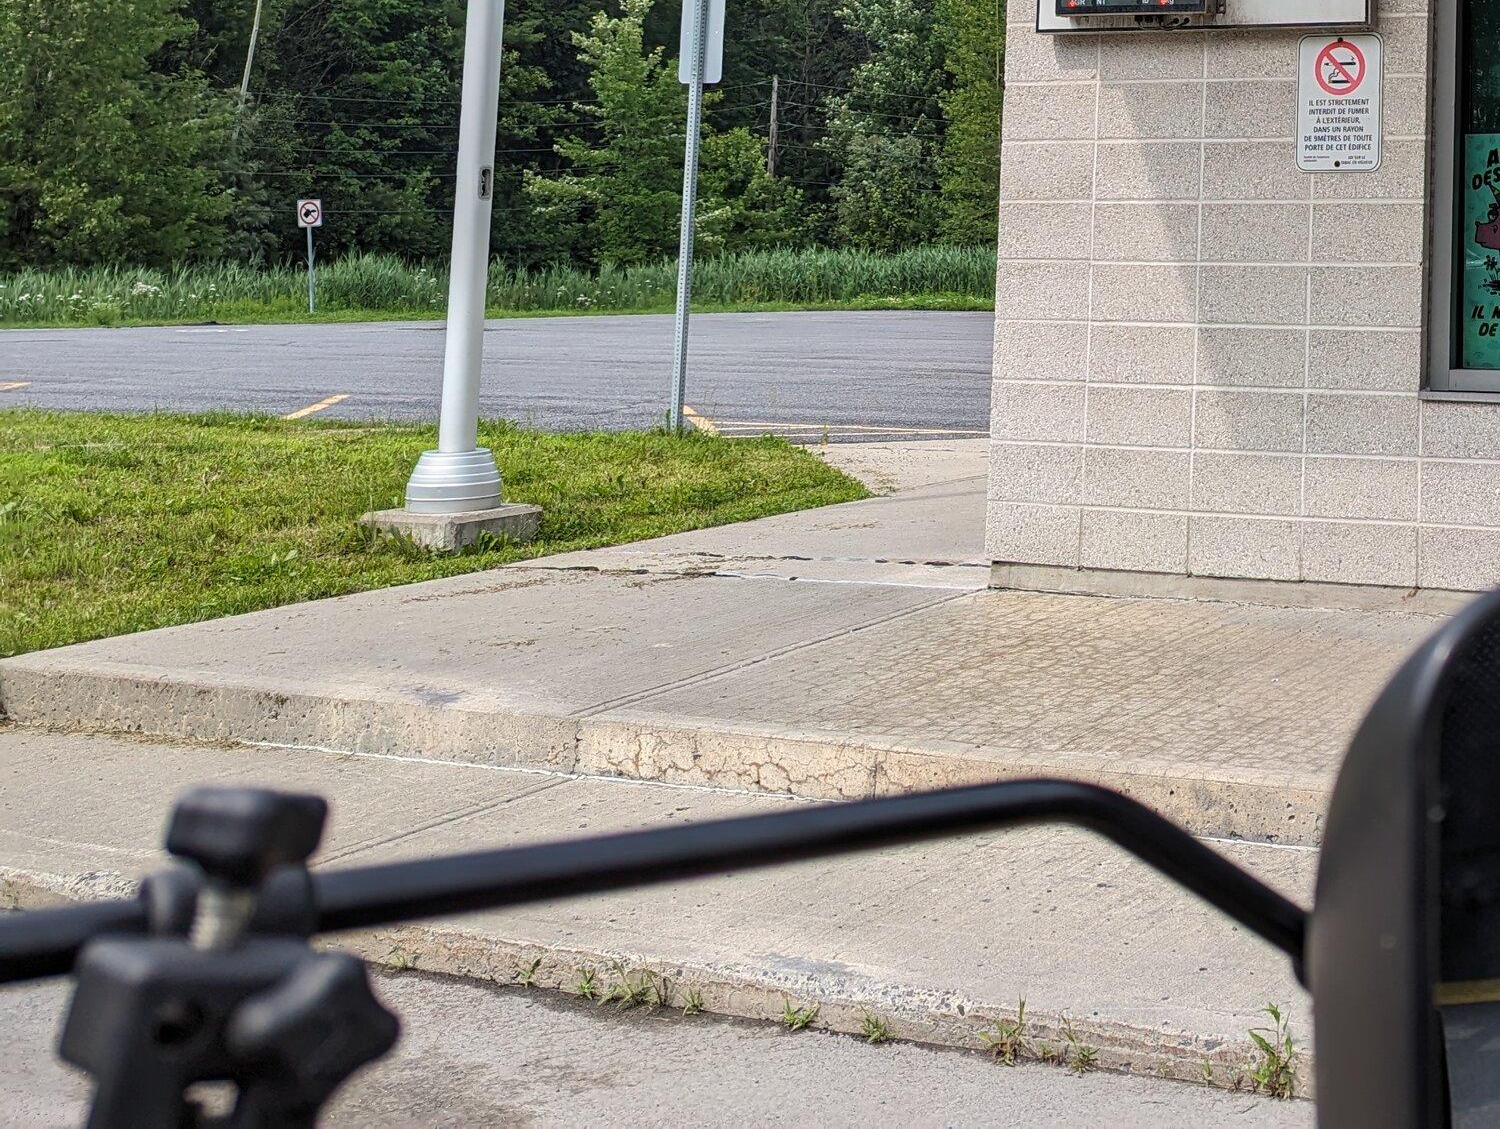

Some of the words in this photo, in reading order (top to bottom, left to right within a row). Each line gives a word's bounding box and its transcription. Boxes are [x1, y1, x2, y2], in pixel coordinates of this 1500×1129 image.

[1353, 134, 1373, 142] TOUTE
[1348, 143, 1372, 151] ÉDIFICE
[1471, 305, 1485, 319] IL
[1478, 322, 1498, 337] DE
